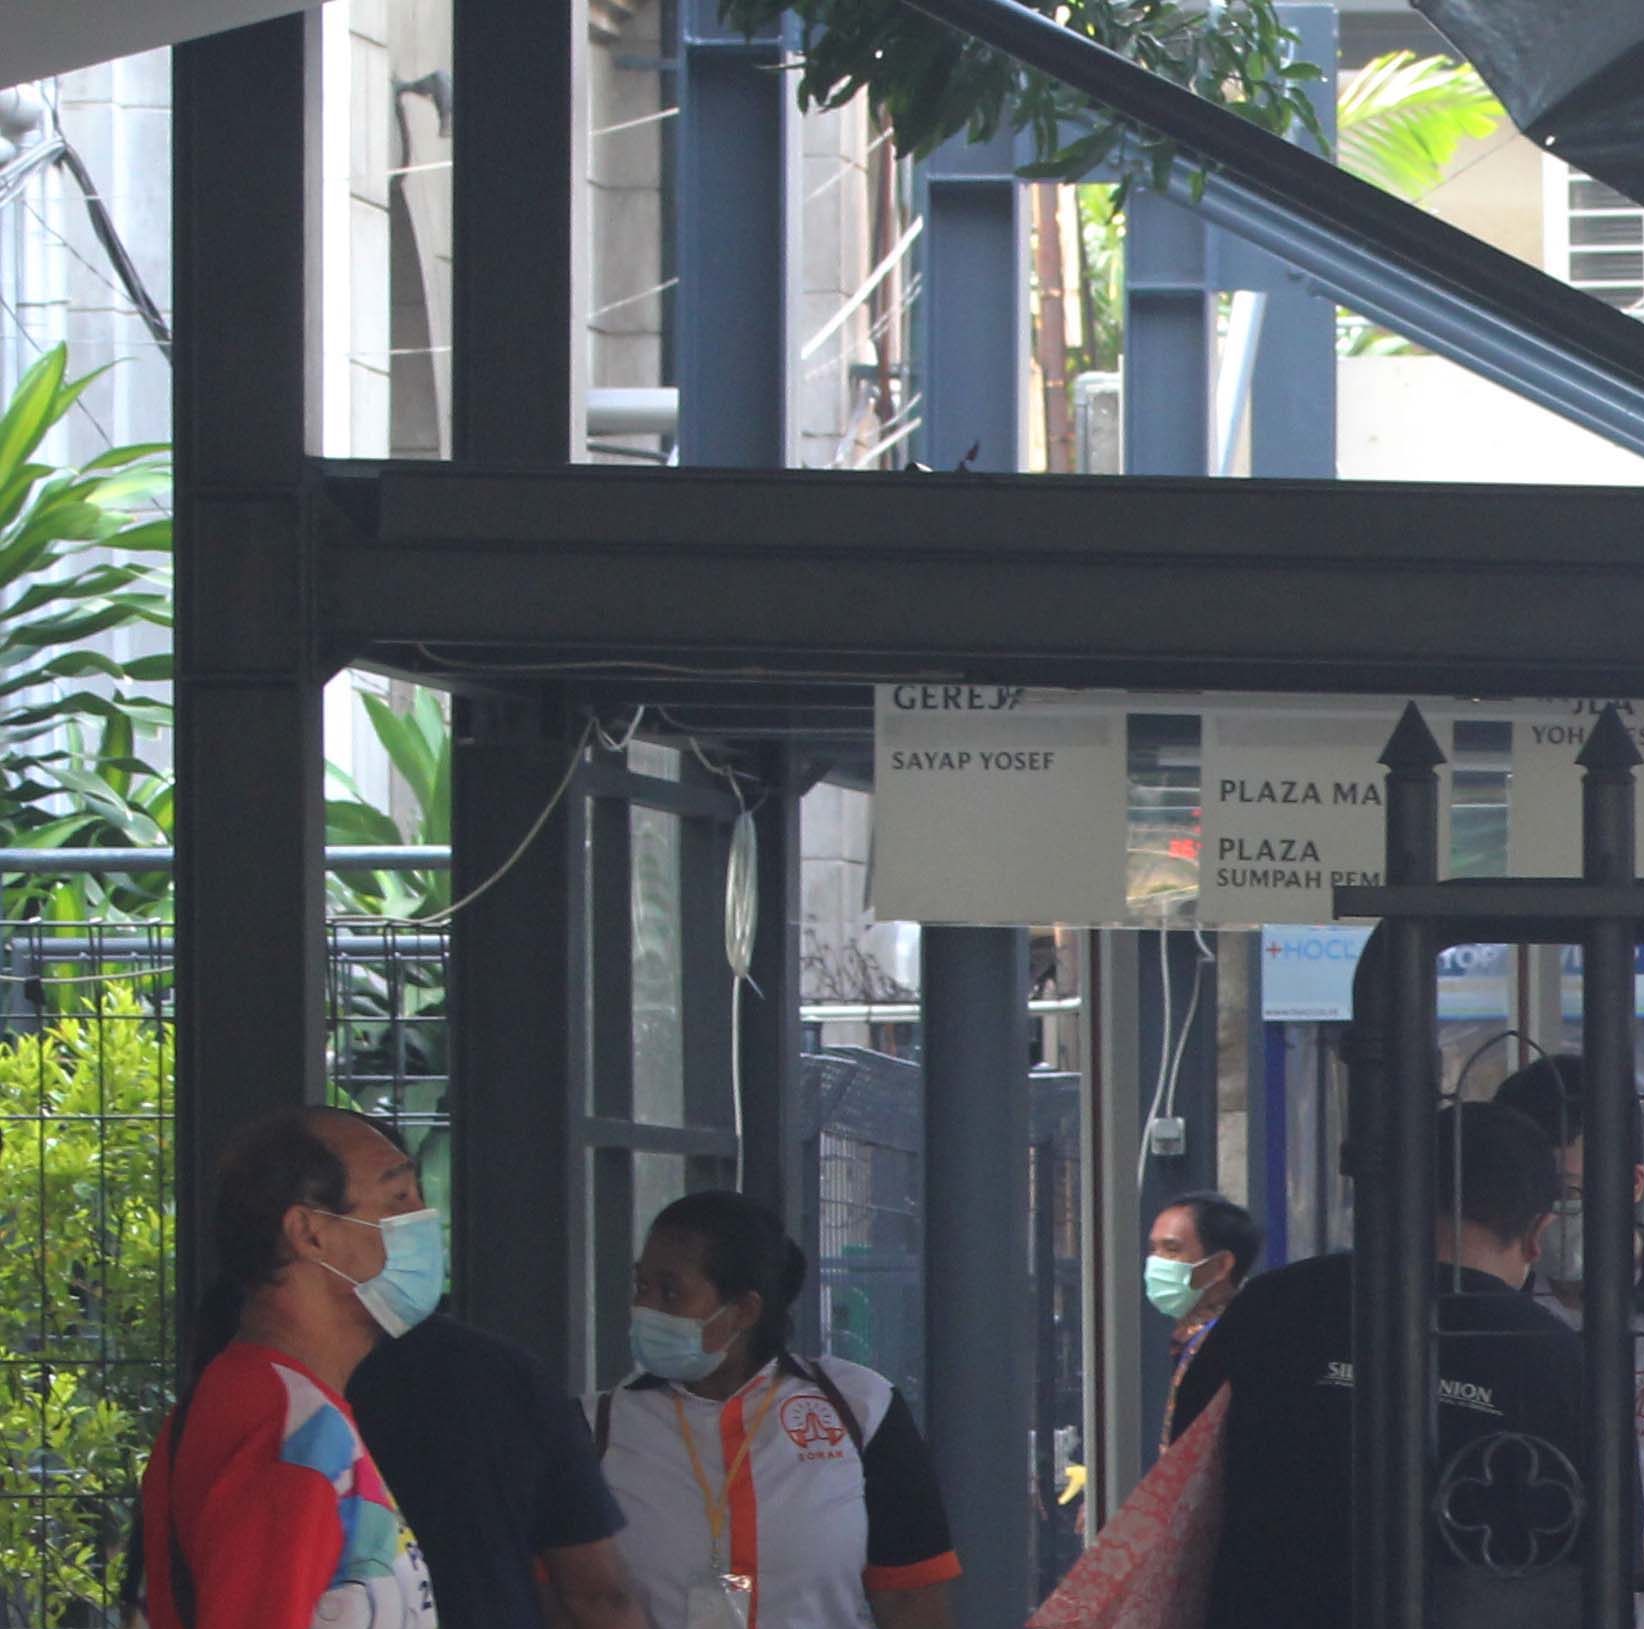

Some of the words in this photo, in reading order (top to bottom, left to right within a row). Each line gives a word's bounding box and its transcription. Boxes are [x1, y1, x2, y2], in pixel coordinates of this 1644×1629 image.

[892, 752, 971, 770] SAYAP
[980, 752, 1055, 770] YOSEF
[1220, 780, 1321, 804] PLAZA
[1219, 838, 1320, 862] PLAZA
[1217, 869, 1321, 888] SUMPAH
